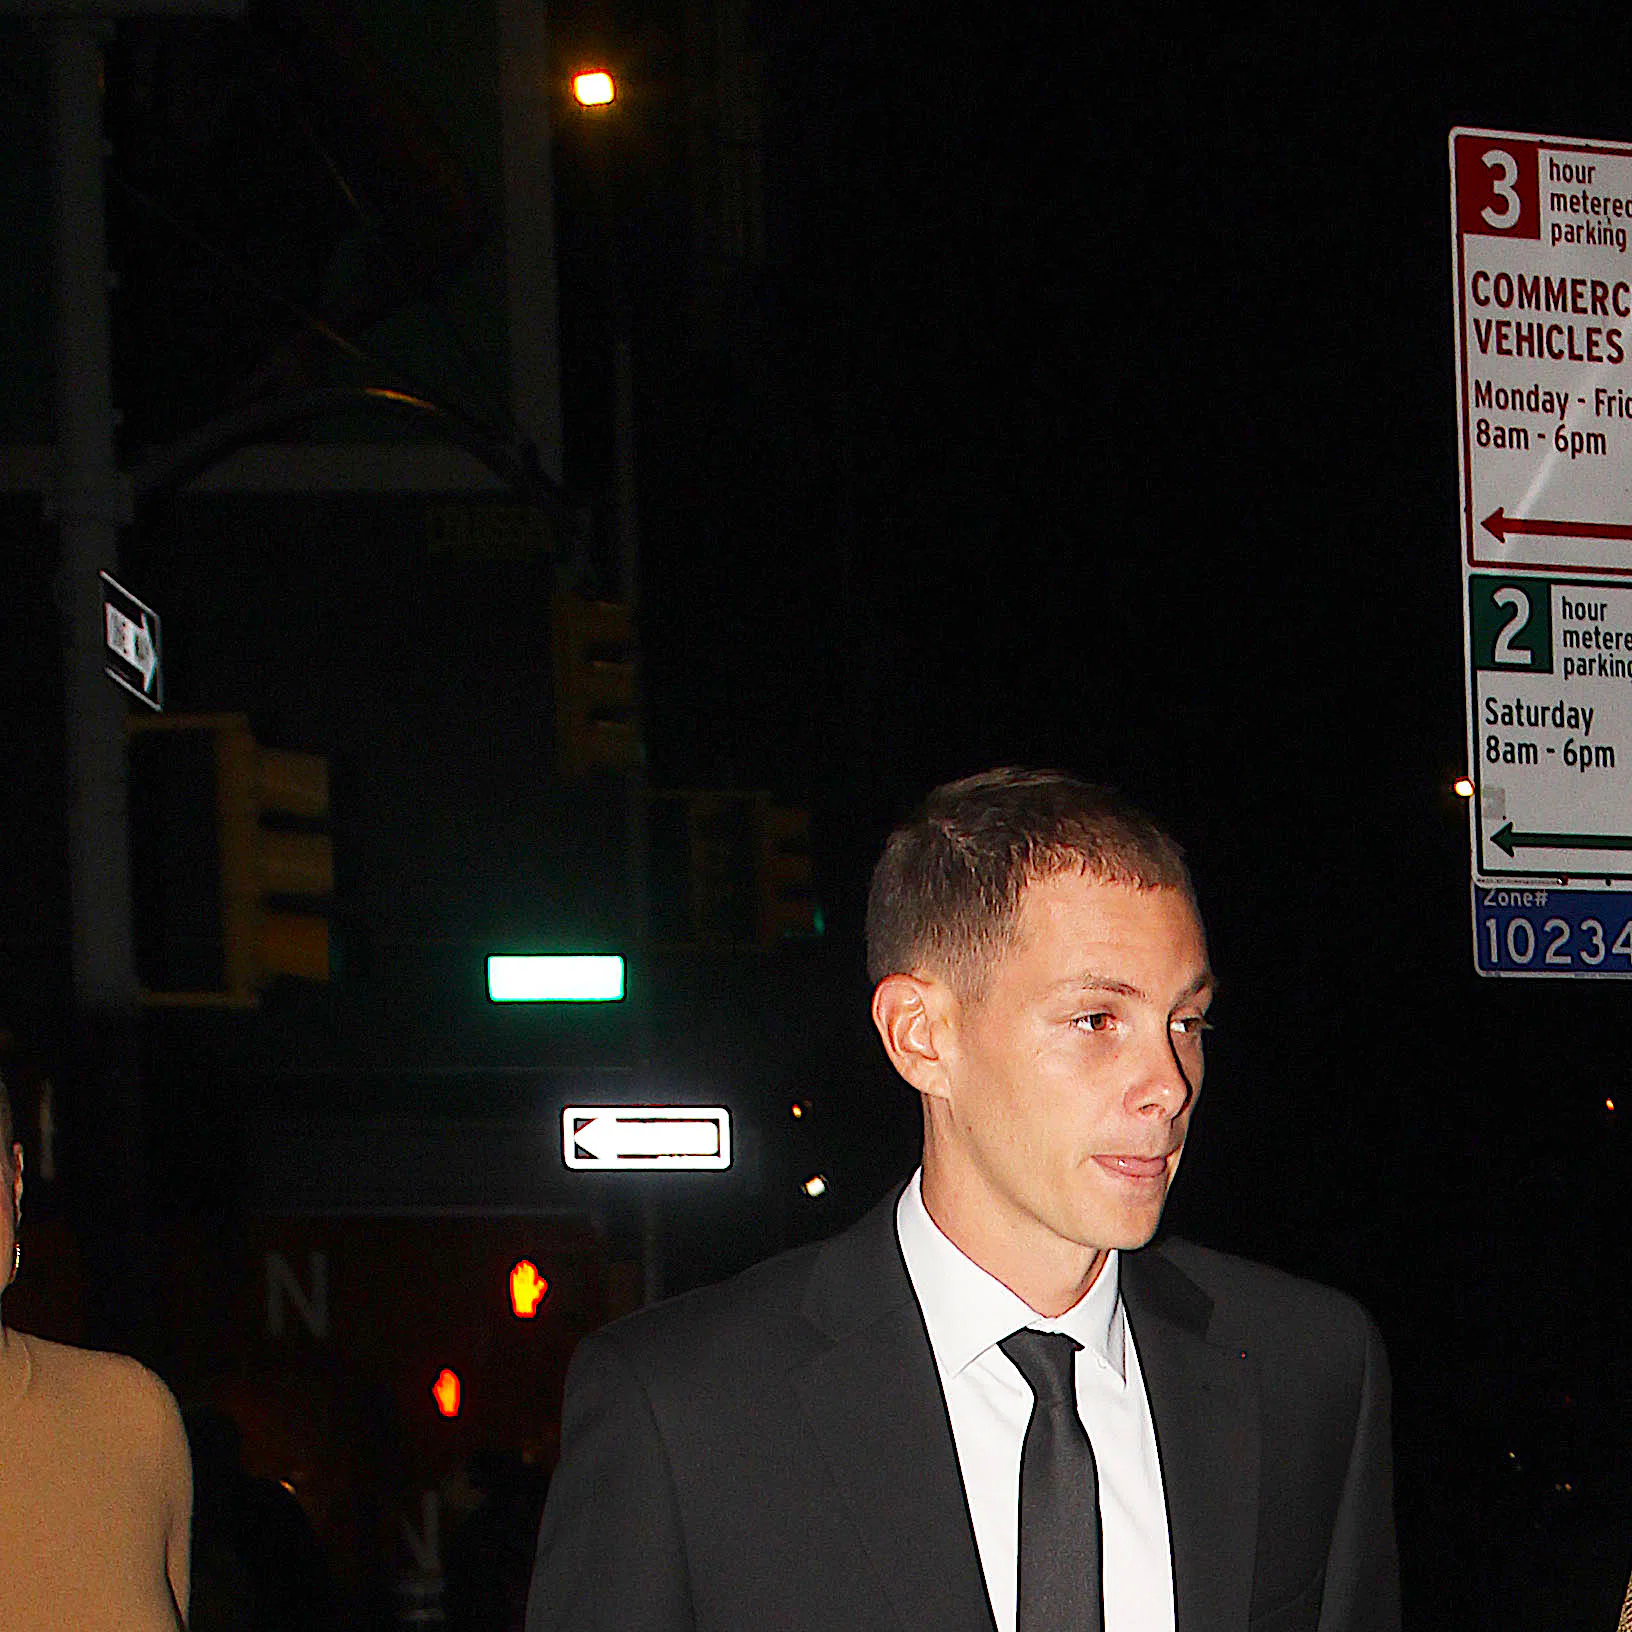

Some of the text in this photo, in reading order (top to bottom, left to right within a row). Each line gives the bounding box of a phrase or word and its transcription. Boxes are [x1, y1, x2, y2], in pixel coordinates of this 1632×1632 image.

[1481, 150, 1521, 229] 3
[1549, 157, 1596, 184] hour
[1551, 219, 1627, 253] parking
[1473, 318, 1625, 364] VEHICLES
[1474, 379, 1569, 421] Monday
[1476, 418, 1529, 450] 8am
[1554, 423, 1607, 460] 6pm
[1493, 587, 1532, 664] 2
[1561, 595, 1607, 622] hour
[1485, 697, 1594, 737] Saturday
[1486, 735, 1538, 764] 8am
[1563, 738, 1616, 773] 6pm
[1484, 887, 1549, 907] Zone#
